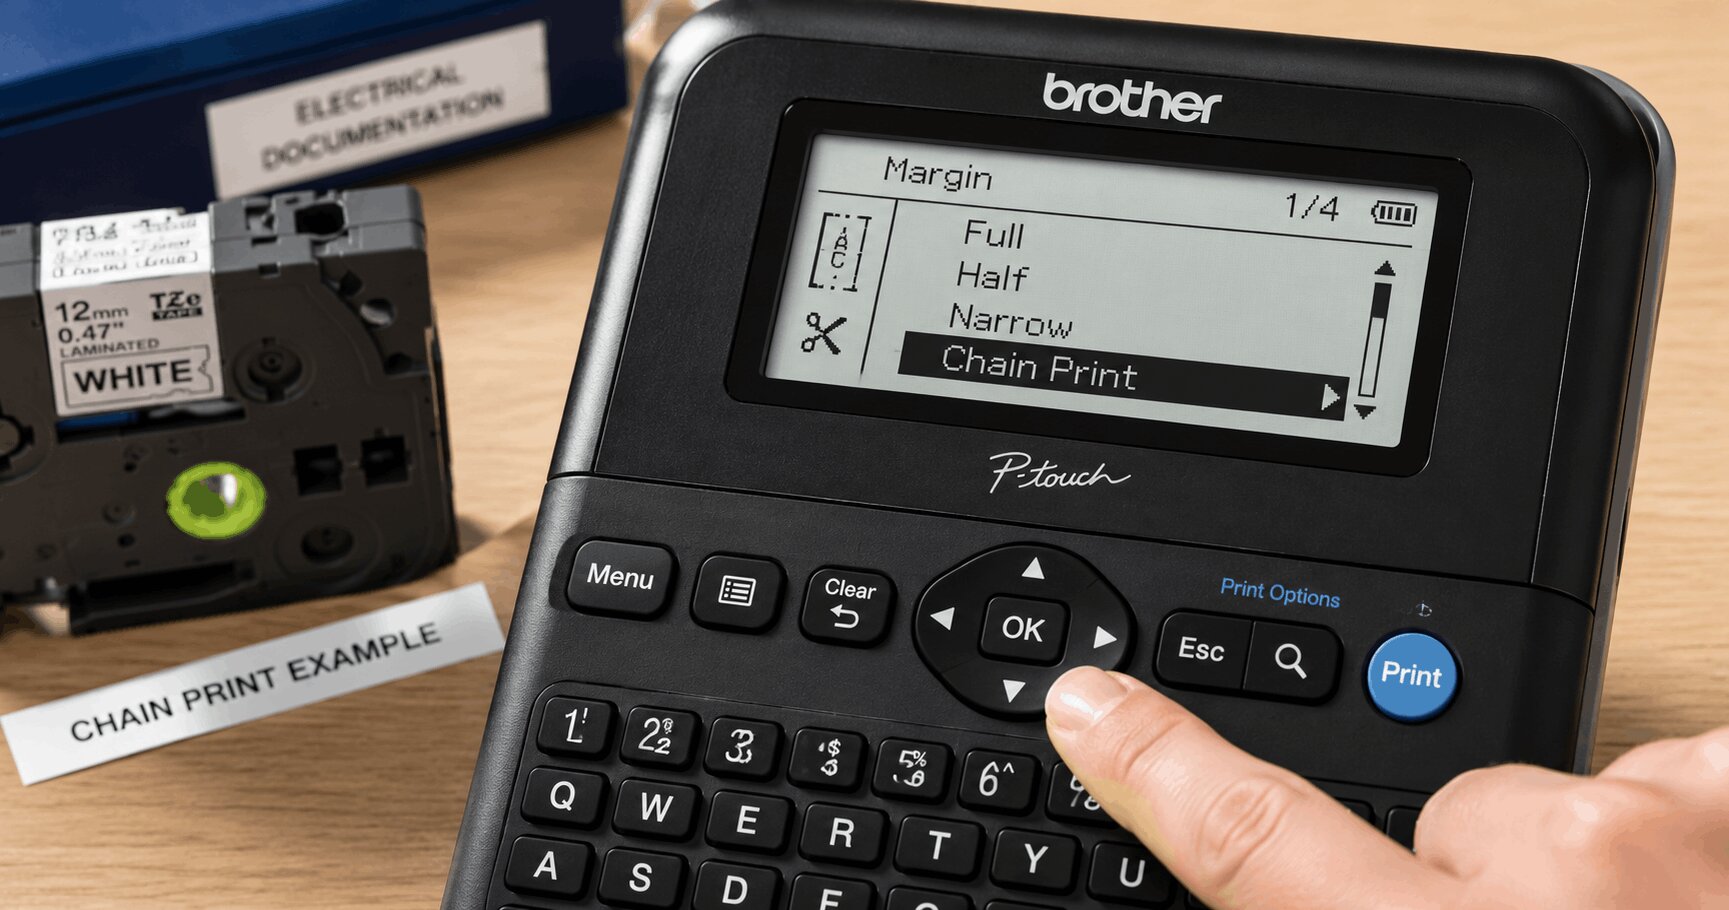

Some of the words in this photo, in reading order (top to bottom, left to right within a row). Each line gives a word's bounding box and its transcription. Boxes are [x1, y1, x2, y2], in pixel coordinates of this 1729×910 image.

[294, 63, 463, 125] ELECTRICAL
[1043, 72, 1222, 124] brother
[260, 87, 504, 172] DOCUMENTATION
[884, 156, 993, 192] Margin
[1286, 192, 1339, 222] 1/4
[964, 219, 1024, 250] Full
[956, 260, 1030, 292] Half
[55, 300, 129, 322] 12mm
[949, 302, 1073, 339] Narrow
[58, 322, 124, 343] 0.47"
[60, 337, 160, 358] LAMINATED
[74, 359, 193, 393] WHITE
[942, 345, 1037, 380] Chain
[1050, 356, 1138, 391] Print
[989, 451, 1131, 494] P-touch
[587, 562, 654, 590] Menu
[825, 577, 877, 600] Clear
[1220, 577, 1265, 599] Print
[1269, 583, 1341, 609] Options
[1002, 615, 1046, 643] OK
[1178, 636, 1225, 662] Esc
[71, 697, 173, 742] CHAIN
[182, 666, 276, 712] PRINT
[287, 622, 442, 682] EXAMPLE
[1381, 660, 1443, 689] Print
[551, 780, 576, 811] Q
[641, 792, 674, 823] W
[736, 805, 761, 835] E
[829, 817, 855, 848] R
[928, 830, 952, 860] T
[1024, 843, 1049, 874] Y
[533, 850, 557, 881] A
[629, 862, 653, 892] S
[1119, 857, 1146, 888] U
[722, 875, 748, 905] D
